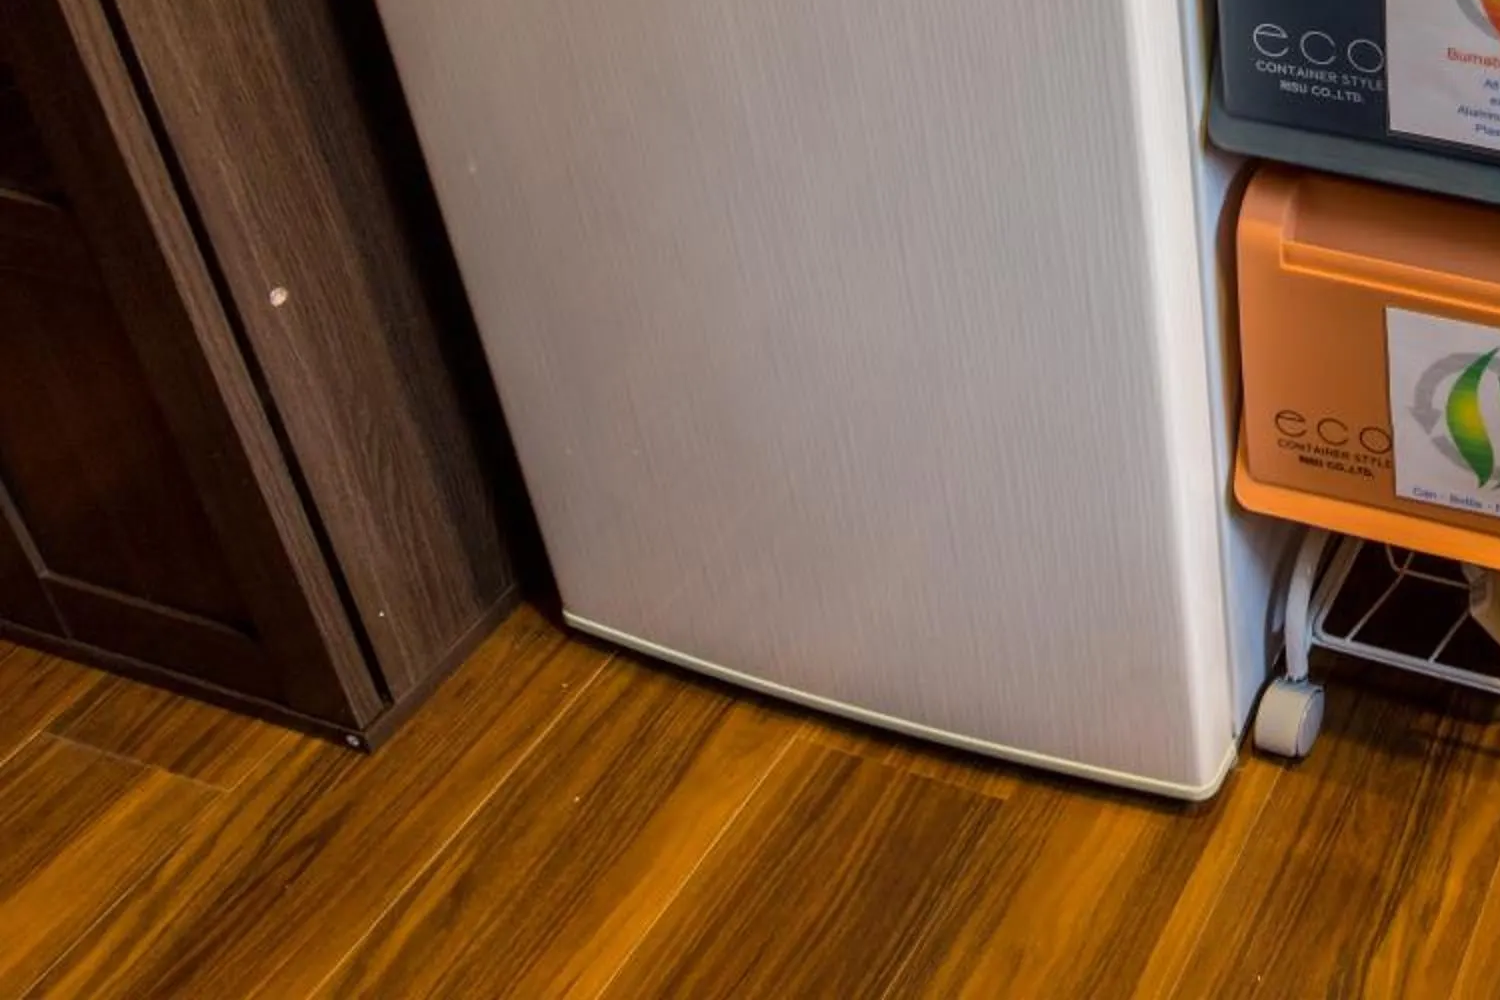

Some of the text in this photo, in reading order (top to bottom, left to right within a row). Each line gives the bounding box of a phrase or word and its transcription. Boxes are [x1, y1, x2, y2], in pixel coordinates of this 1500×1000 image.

[1253, 23, 1384, 73] eco
[1255, 59, 1385, 91] CONTAINER STYLE
[1279, 79, 1307, 94] RISU
[1484, 78, 1499, 89] All
[1275, 410, 1393, 454] eco
[1277, 438, 1393, 469] CONTAINER STYLE
[1412, 487, 1437, 499] Can
